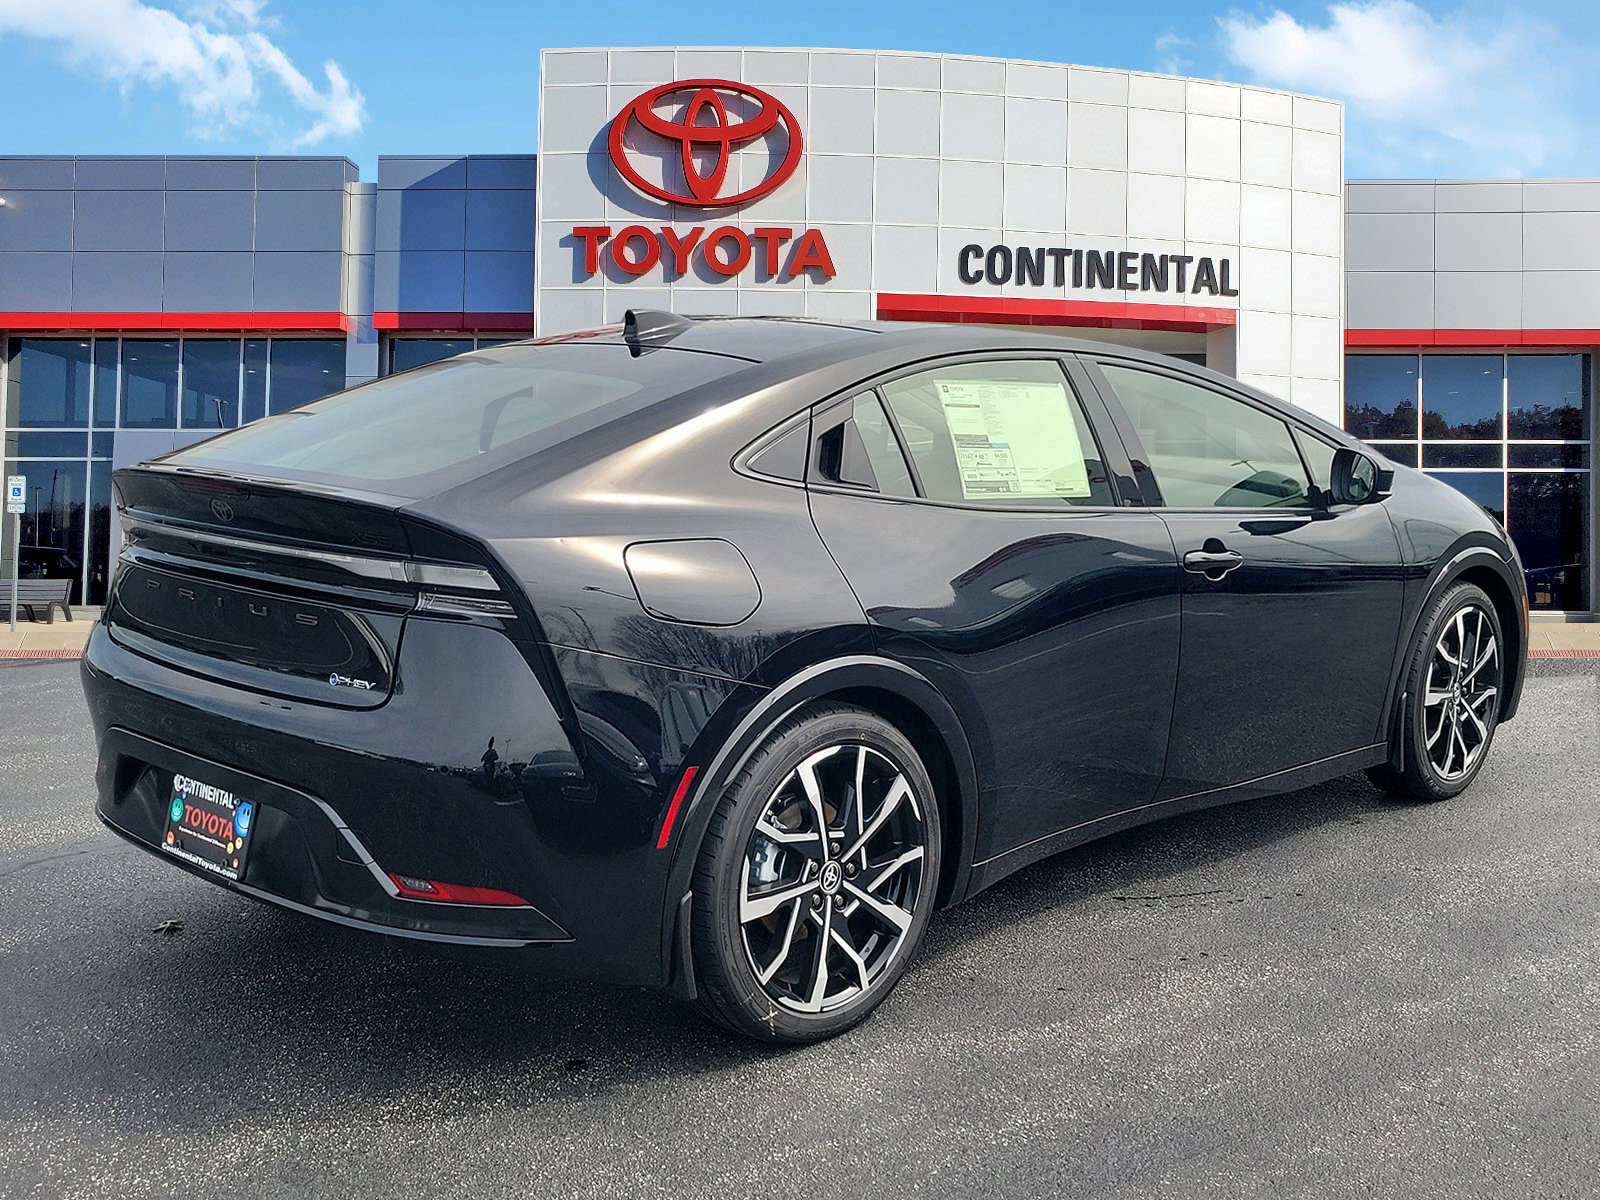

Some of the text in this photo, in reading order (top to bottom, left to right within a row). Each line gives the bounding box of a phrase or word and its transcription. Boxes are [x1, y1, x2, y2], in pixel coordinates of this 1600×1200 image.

[572, 225, 837, 277] TOYOTA
[959, 244, 1239, 296] CONTINENTAL
[147, 579, 318, 626] PRIUS
[338, 676, 377, 690] PHEV
[174, 774, 234, 809] CONTINENTAL
[184, 804, 233, 841] TOYOTA
[161, 842, 238, 880] ContinentalToyota.com
